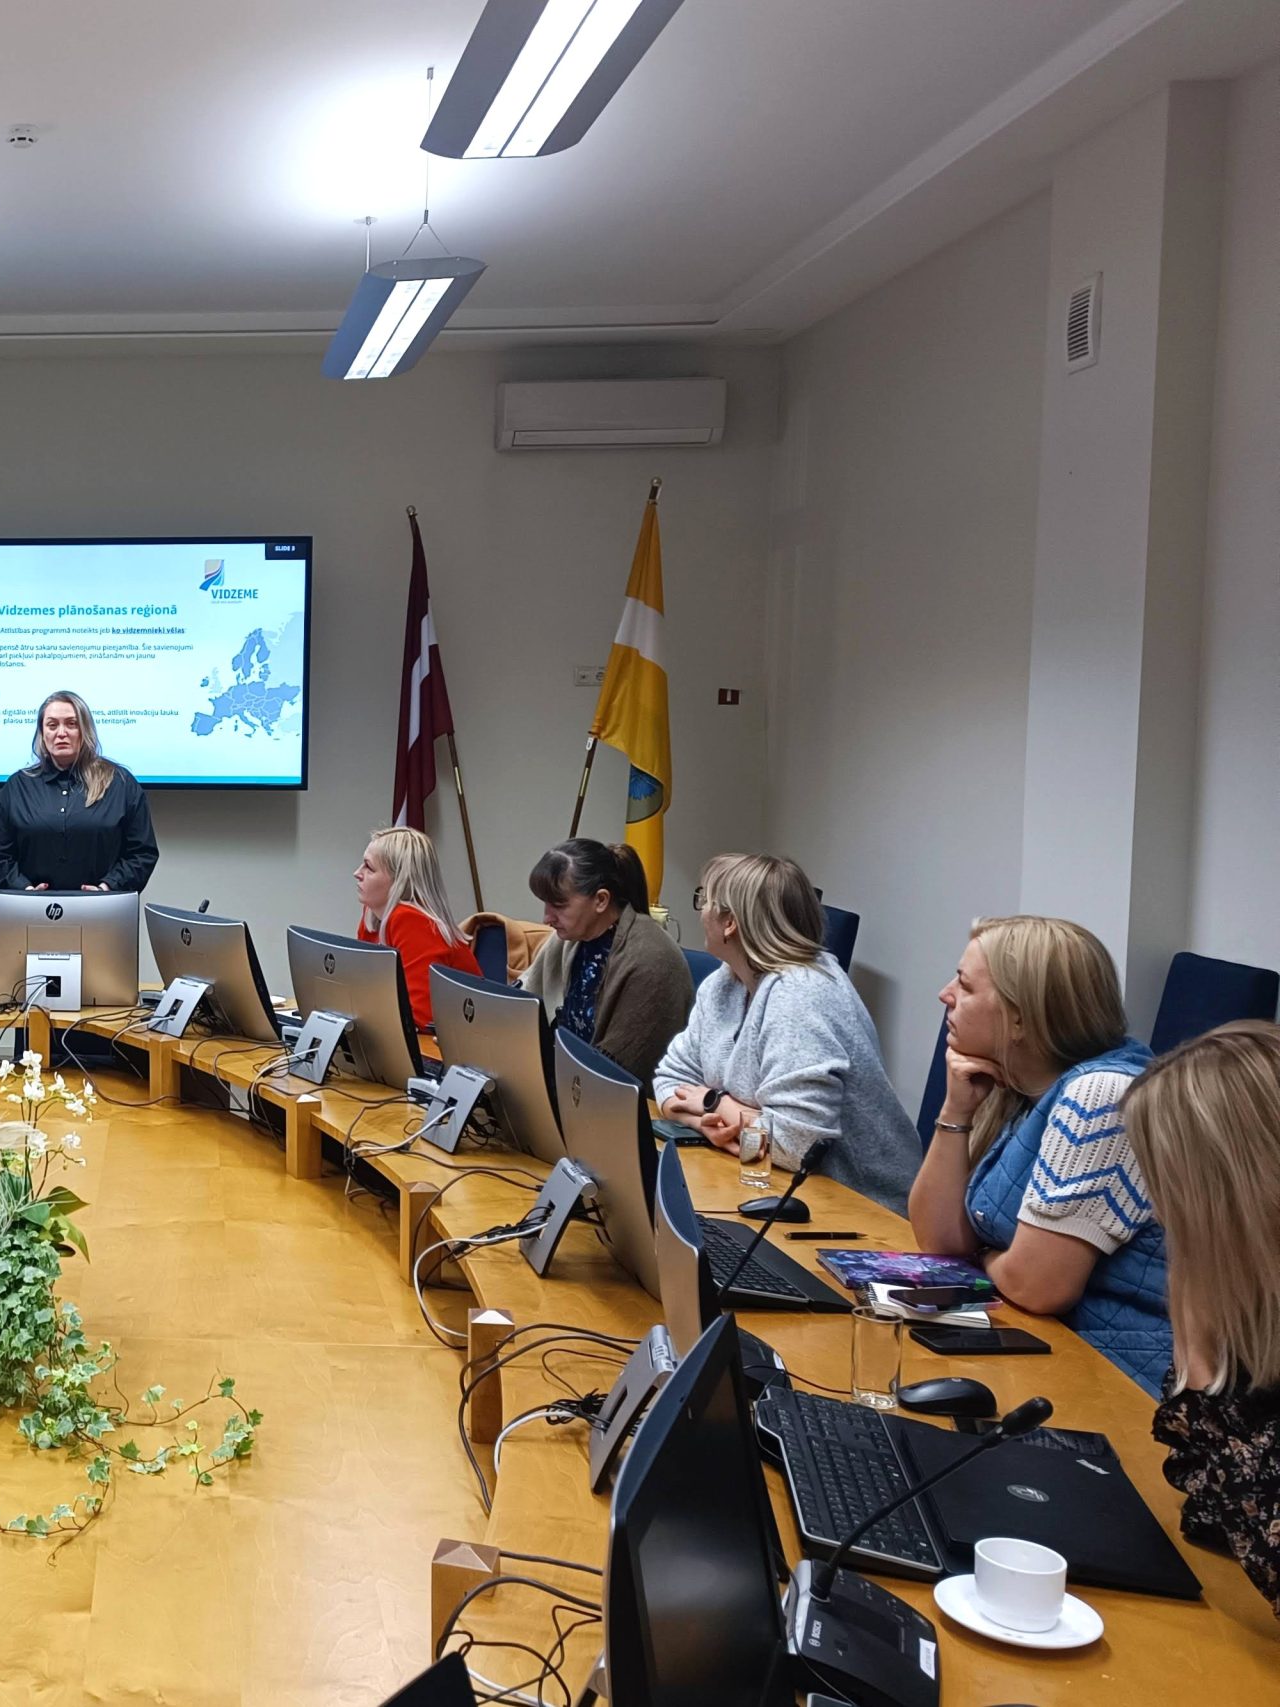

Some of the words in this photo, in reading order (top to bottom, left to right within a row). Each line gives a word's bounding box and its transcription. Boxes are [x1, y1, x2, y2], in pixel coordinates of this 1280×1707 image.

[211, 588, 259, 599] VIDZEME
[58, 604, 128, 618] plānošanas
[131, 604, 178, 618] reģionā
[32, 627, 71, 636] programmā
[99, 627, 111, 636] jeb
[111, 627, 120, 635] ko
[122, 627, 165, 635] vidzemnieki
[58, 644, 101, 653] savienojumu
[141, 642, 152, 651] Šie
[153, 644, 194, 653] savienojumi
[135, 653, 156, 661] jaunu
[2, 708, 27, 717] digitālo
[3, 717, 24, 726] plaisu
[45, 903, 63, 921] hp
